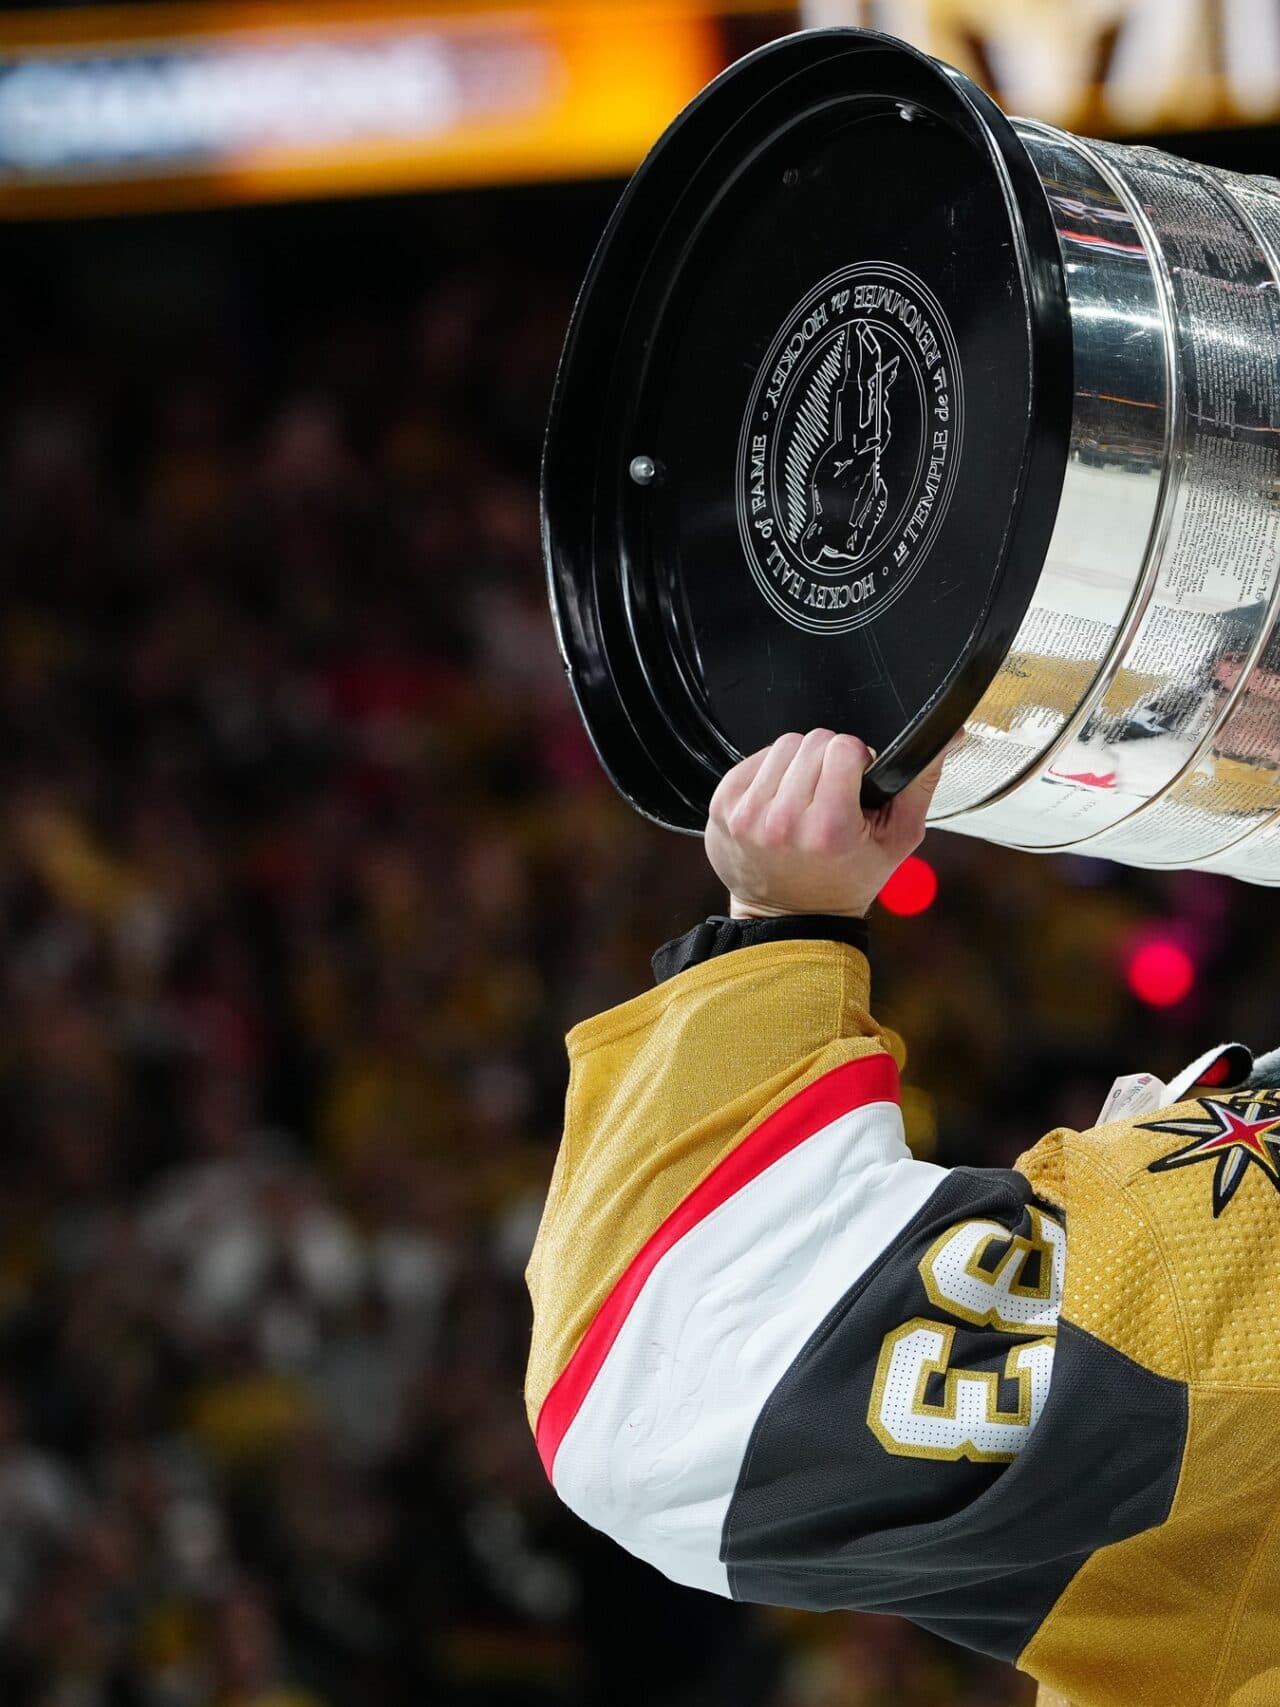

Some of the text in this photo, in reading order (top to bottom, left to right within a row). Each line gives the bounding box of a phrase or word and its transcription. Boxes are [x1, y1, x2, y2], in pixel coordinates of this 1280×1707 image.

[750, 434, 876, 610] HOCKEY HALL of FAME
[766, 284, 949, 568] LE TEMPLE de LA RENOMMÉE du HOCKEY
